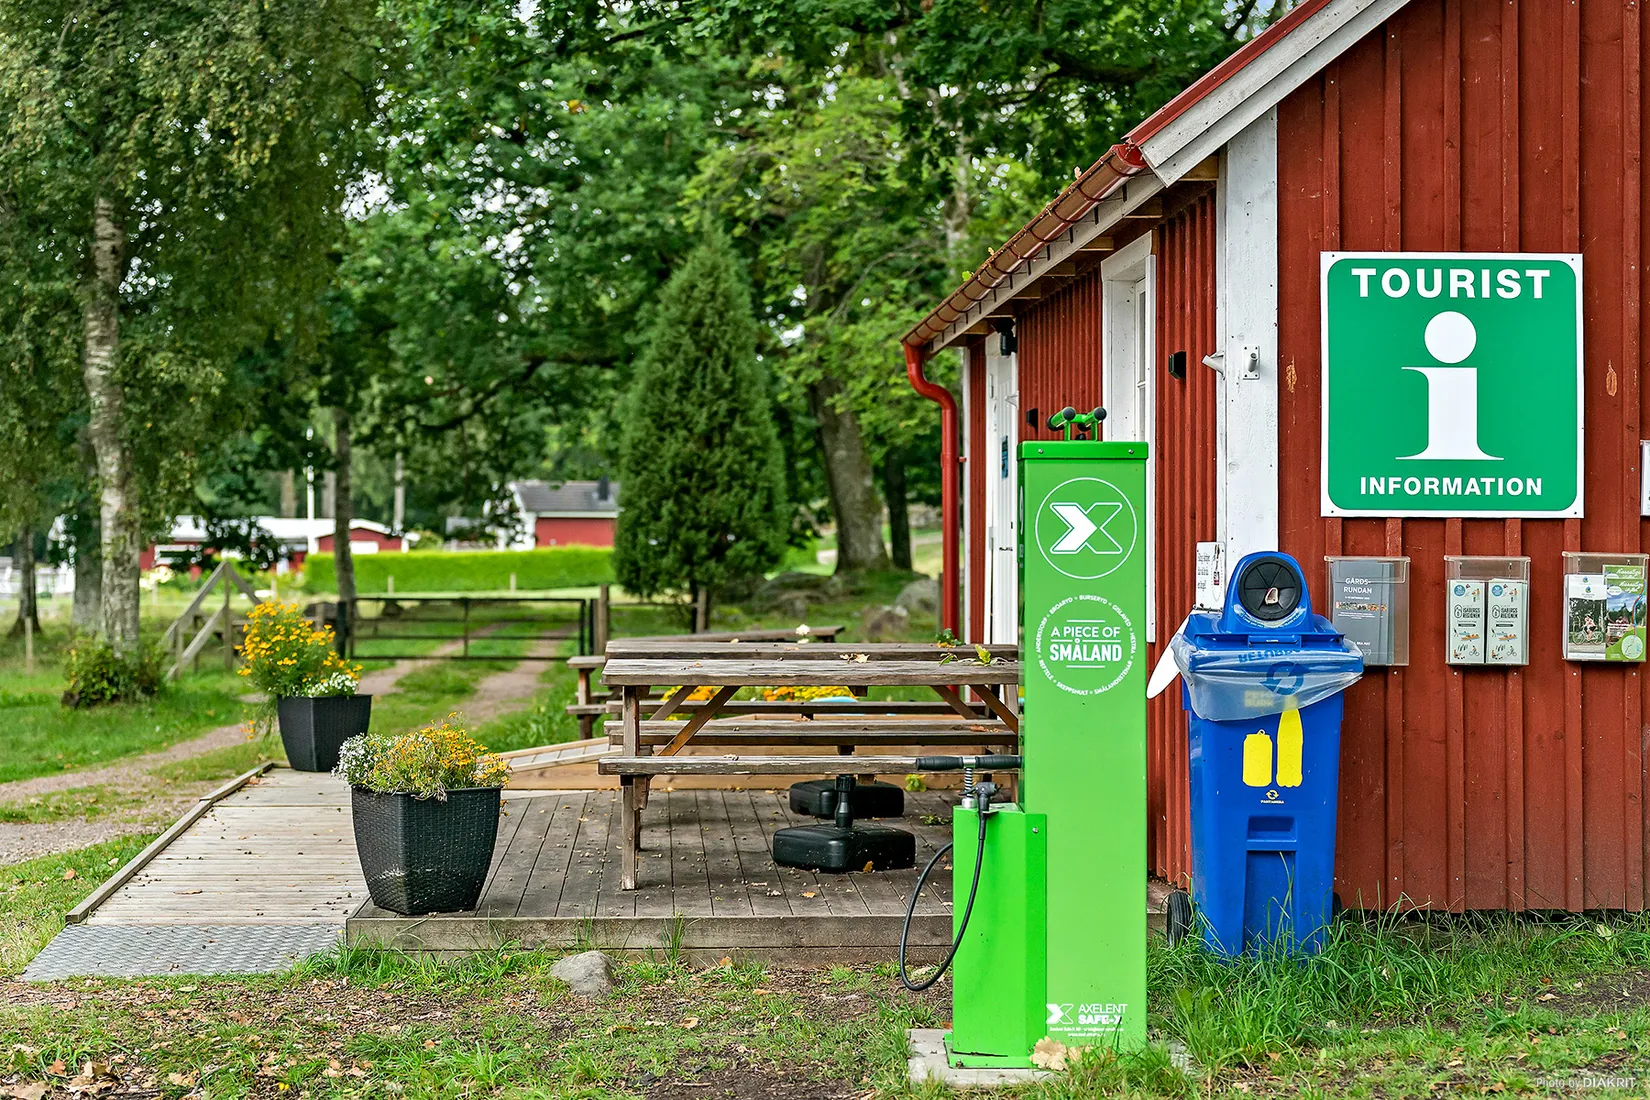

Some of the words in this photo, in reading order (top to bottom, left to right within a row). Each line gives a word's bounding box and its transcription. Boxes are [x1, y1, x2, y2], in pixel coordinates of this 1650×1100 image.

[1351, 268, 1551, 298] TOURIST
[1360, 477, 1543, 496] INFORMATION
[1343, 586, 1372, 594] RUNDAN
[1035, 617, 1048, 653] ANDERSTORP
[1049, 597, 1073, 614] BROARYD
[1079, 595, 1108, 604] BURSERYD
[1112, 604, 1132, 627] GISLAVED
[1129, 632, 1137, 654] HESTRA
[1050, 626, 1061, 638] A
[1063, 626, 1099, 638] PIECE
[1102, 626, 1121, 638] OF
[1049, 637, 1122, 662] SMÅLAND
[1039, 659, 1054, 680] REFTELE
[1056, 681, 1089, 696] SKEPPSHULT
[1093, 660, 1133, 695] SMÅLANDSSTENAR
[1078, 1003, 1128, 1014] AXELENT
[1078, 1014, 1123, 1025] SAFE-X
